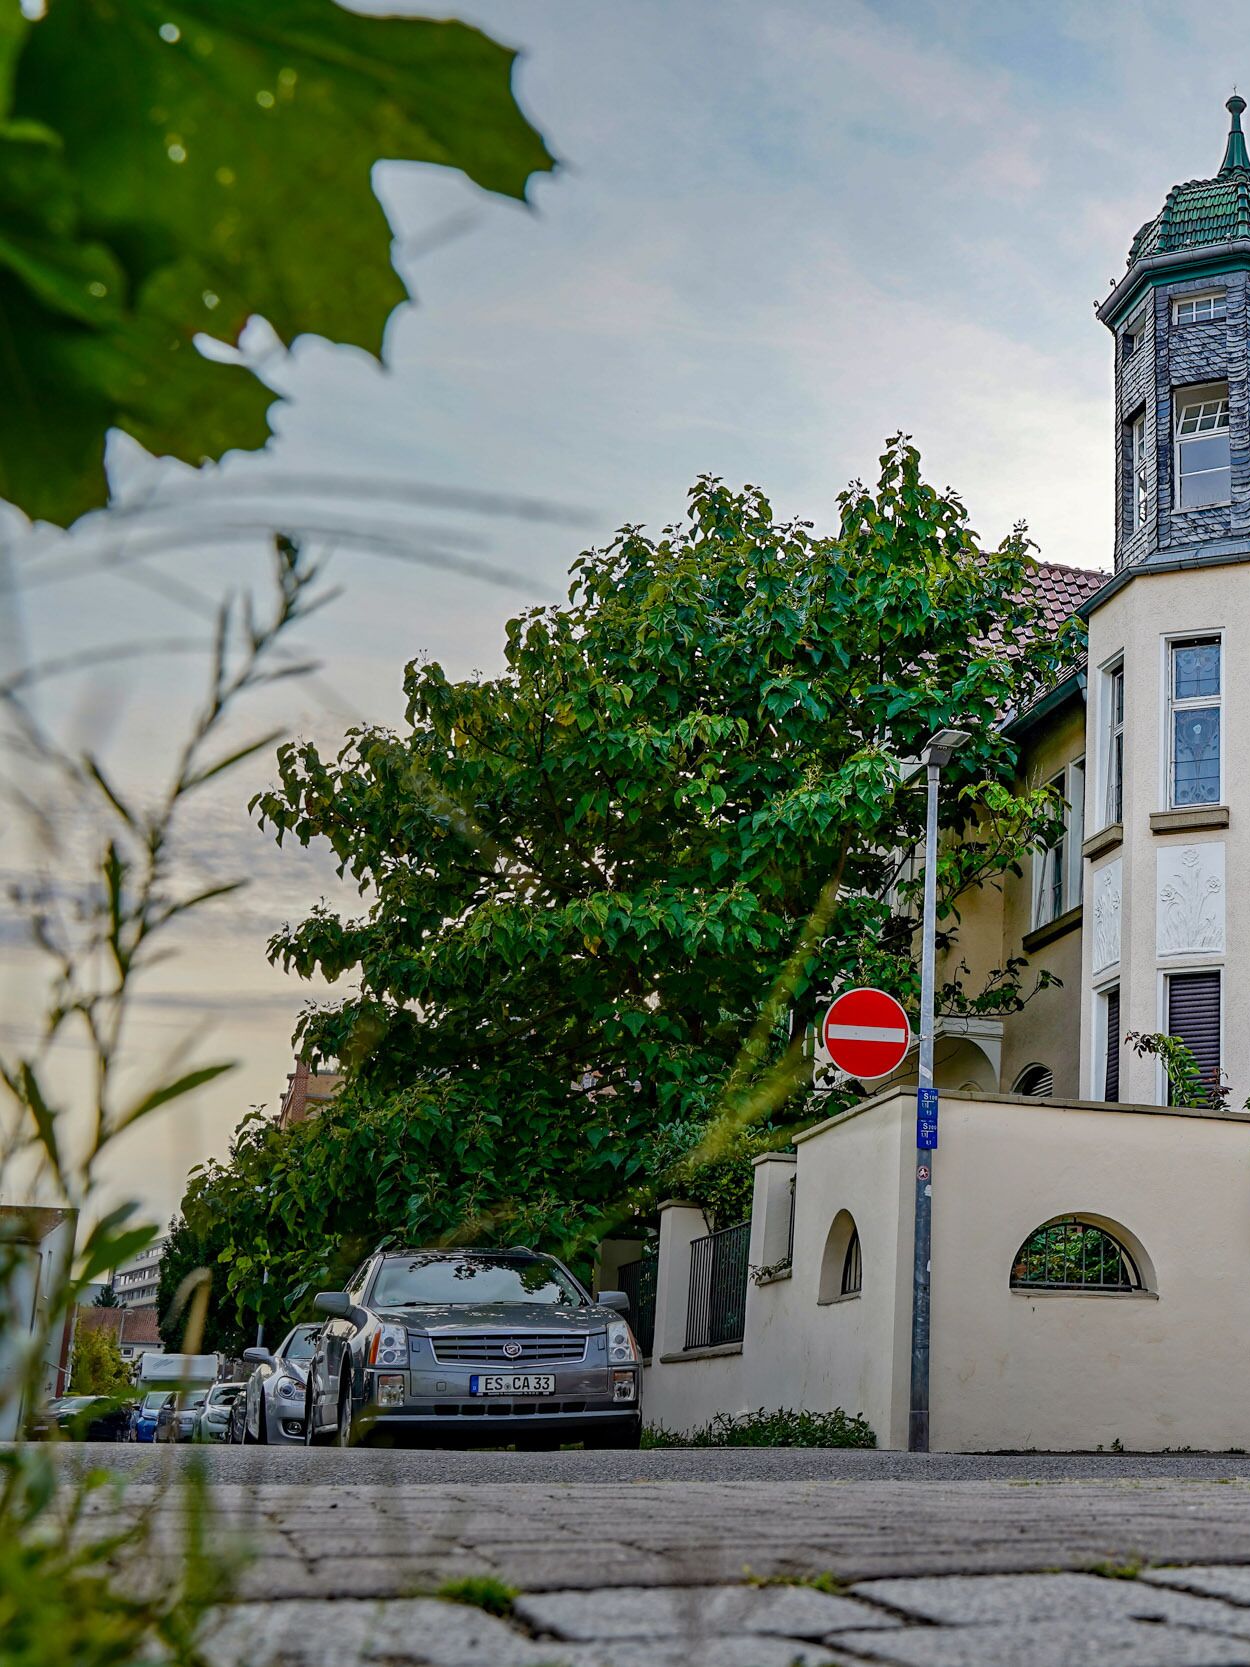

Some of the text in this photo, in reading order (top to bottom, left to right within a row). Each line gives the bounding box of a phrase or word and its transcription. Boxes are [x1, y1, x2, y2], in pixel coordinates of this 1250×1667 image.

[484, 1377, 503, 1391] ES
[512, 1376, 530, 1390] CA
[533, 1376, 550, 1390] 33
